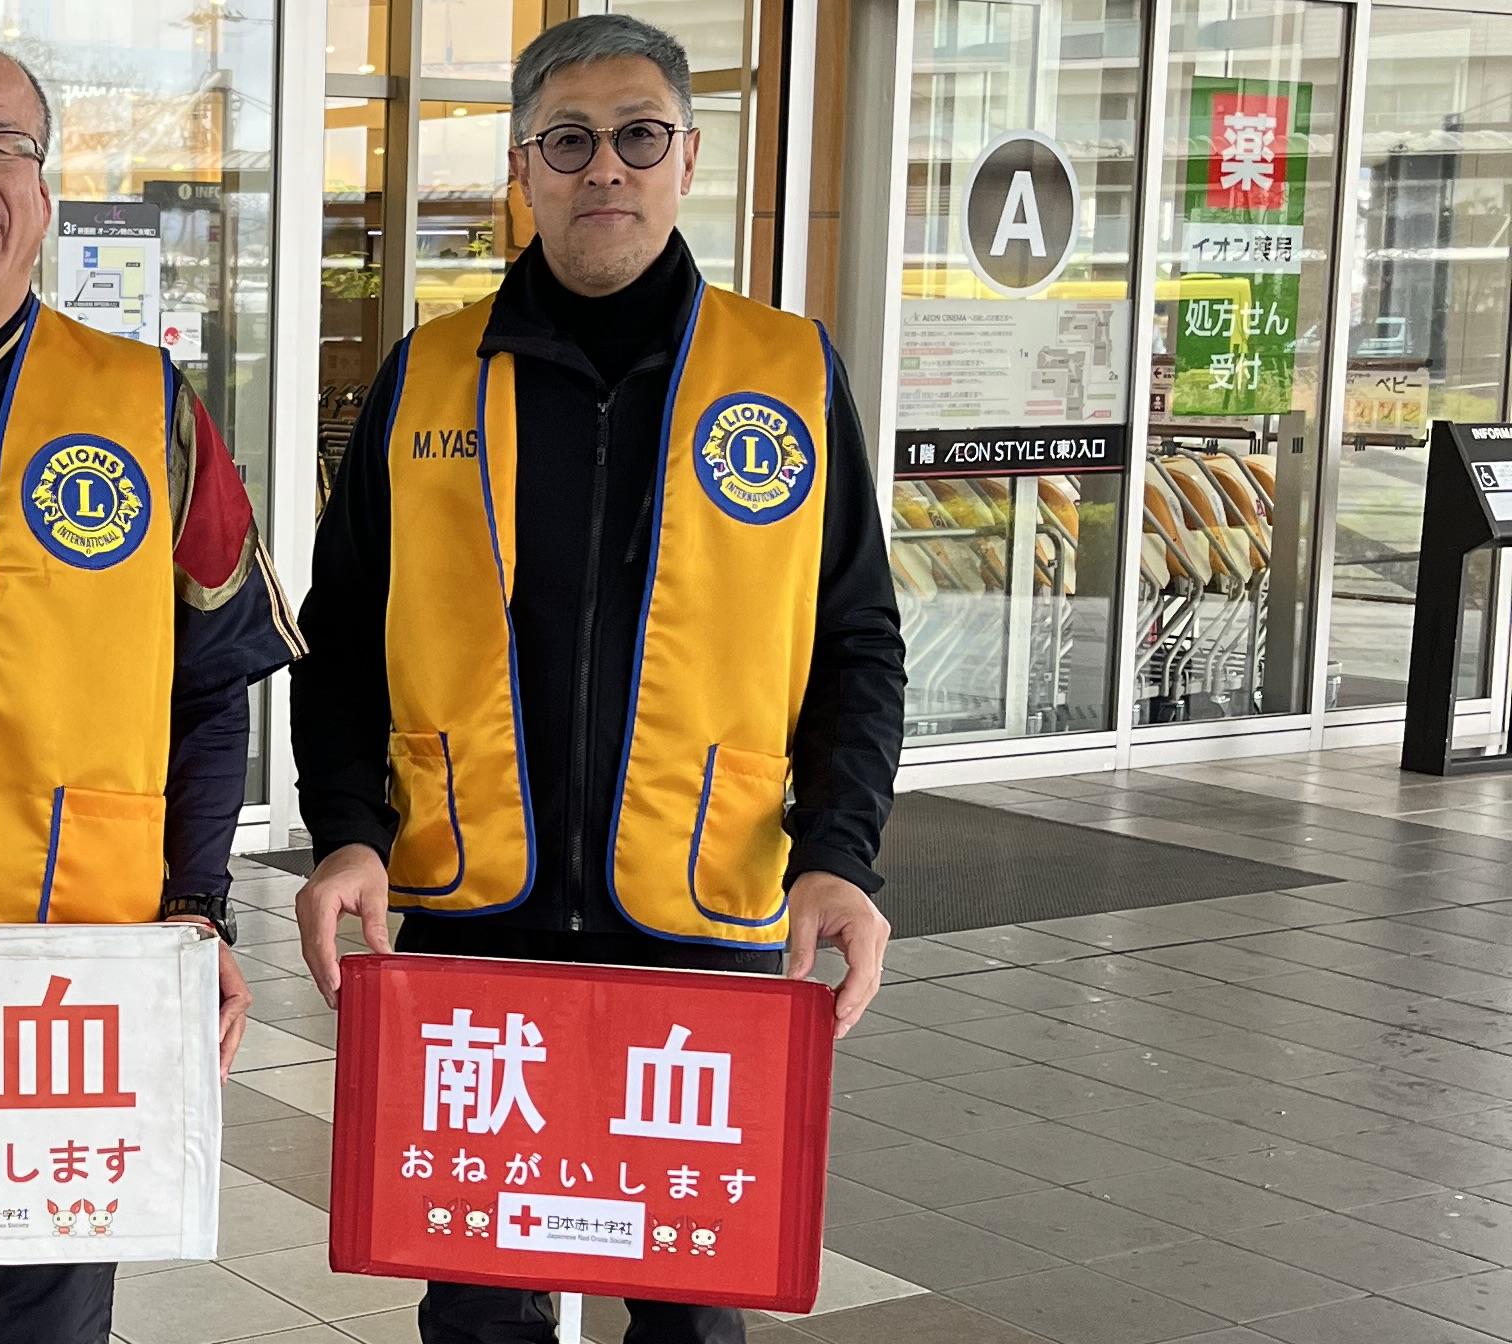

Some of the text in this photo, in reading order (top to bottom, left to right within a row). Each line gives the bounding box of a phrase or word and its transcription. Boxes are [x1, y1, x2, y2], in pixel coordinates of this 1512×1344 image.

[1219, 111, 1277, 191] 薬
[63, 221, 77, 235] 3F
[989, 170, 1047, 257] A
[1192, 235, 1293, 264] イオン薬局
[1185, 300, 1289, 338] 処方せん
[1209, 351, 1263, 391] 受付
[1375, 375, 1422, 394] ベビー
[723, 407, 784, 432] LIONS
[412, 428, 478, 461] M.YAS
[742, 436, 769, 475] L
[907, 444, 936, 465] 1階
[994, 440, 1046, 462] STYLE
[1049, 439, 1106, 460] (東)入口
[55, 449, 120, 475] LIONS
[76, 479, 105, 518] L
[57, 525, 121, 548] INTERNATIONAL
[421, 1007, 743, 1145] 献血
[400, 1144, 757, 1205] おねがいします
[547, 1215, 633, 1236] 日本赤十字社
